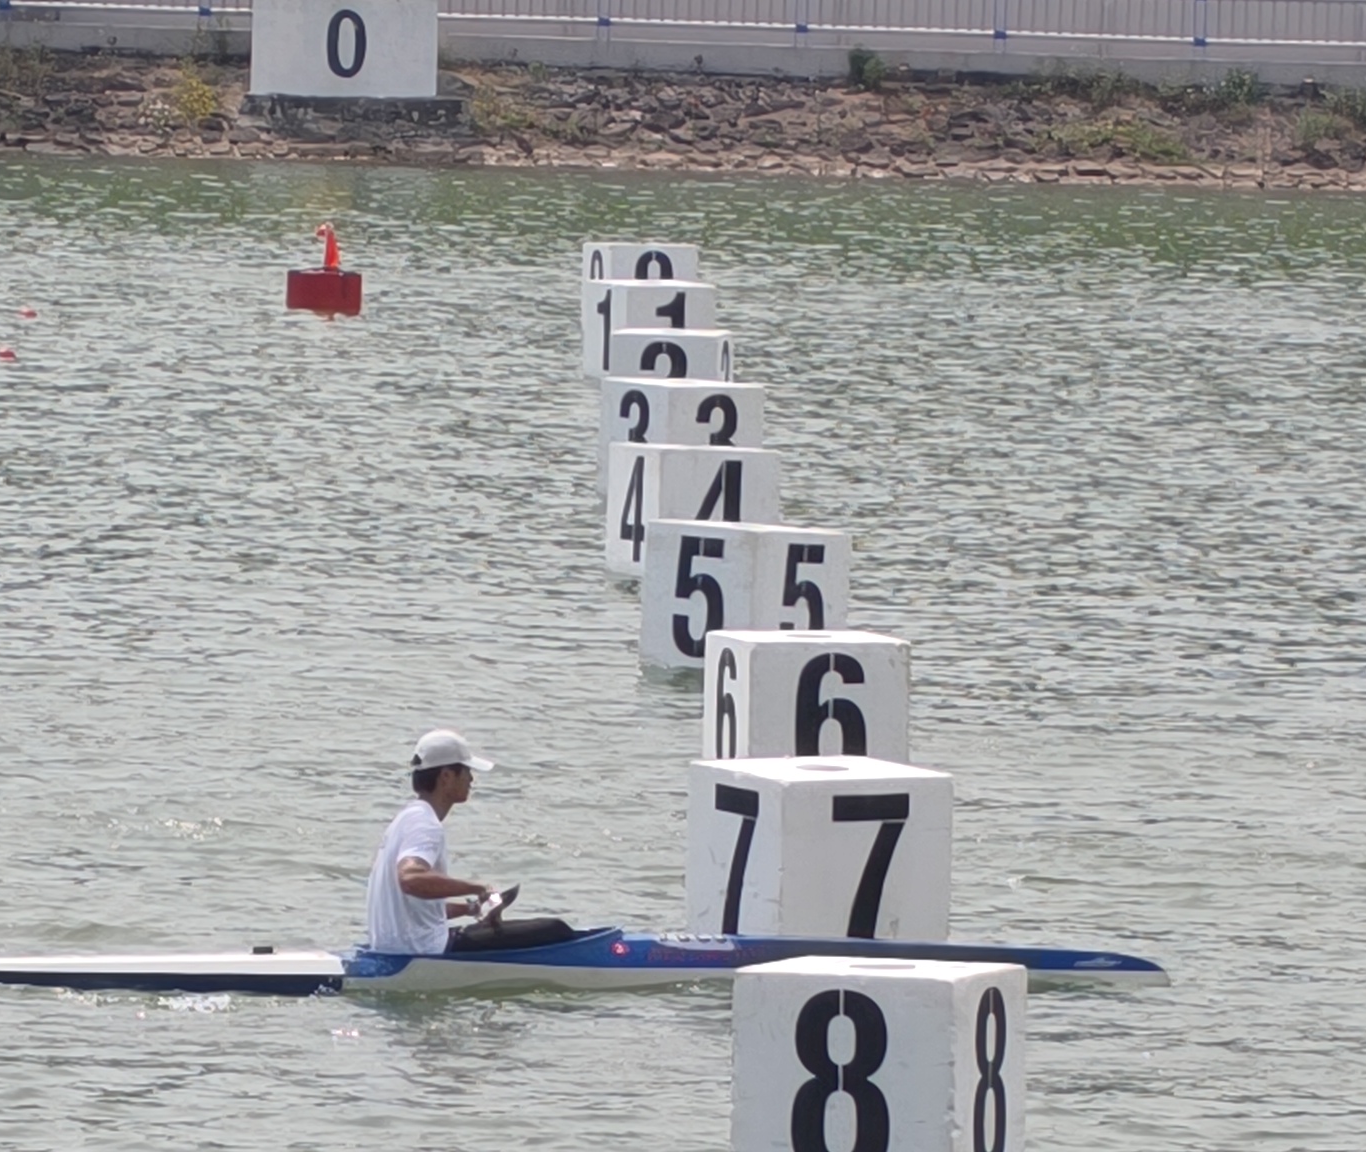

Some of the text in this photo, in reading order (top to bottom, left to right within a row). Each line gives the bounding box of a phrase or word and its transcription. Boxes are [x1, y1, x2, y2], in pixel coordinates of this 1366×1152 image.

[327, 9, 367, 78] 0
[597, 289, 611, 371] 1
[620, 456, 645, 562] 4
[672, 535, 725, 658] 5
[780, 543, 825, 630] 5
[716, 648, 737, 759] 6
[795, 652, 867, 757] 6
[715, 783, 759, 936] 7
[832, 793, 910, 939] 7
